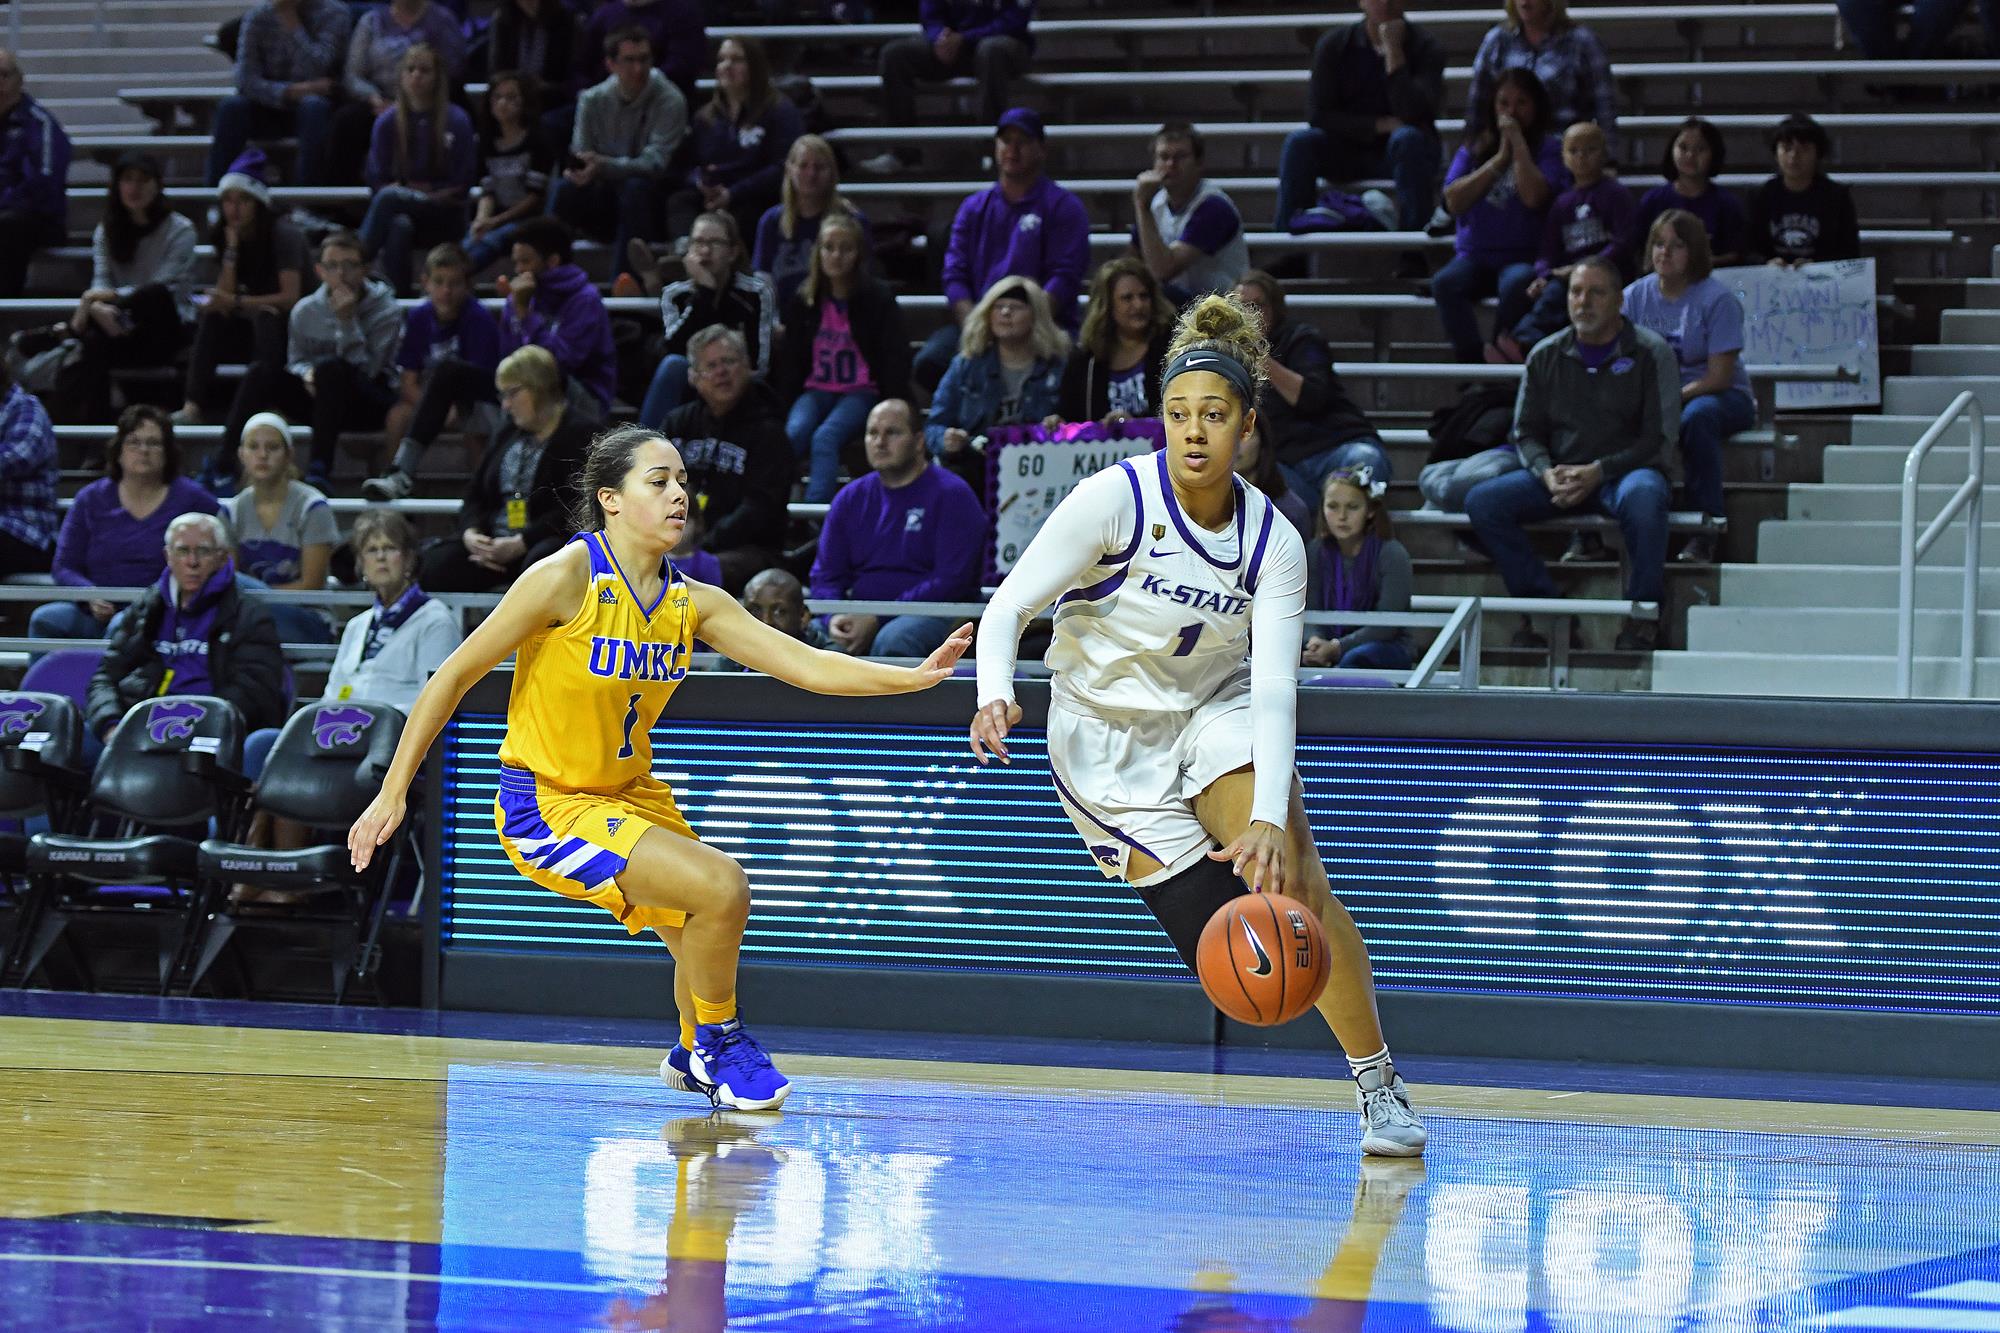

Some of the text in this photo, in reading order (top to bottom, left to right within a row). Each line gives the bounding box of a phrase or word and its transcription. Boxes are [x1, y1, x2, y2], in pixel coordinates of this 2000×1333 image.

[815, 348, 857, 383] 50
[1018, 454, 1045, 477] GO
[1140, 573, 1253, 615] K-STATE
[1171, 620, 1207, 658] 1
[587, 634, 687, 683] UMKC
[616, 692, 644, 760] 1
[48, 850, 126, 863] KANSAS STATE
[220, 859, 297, 872] KANSAS STATE
[1285, 909, 1311, 969] ELITE
